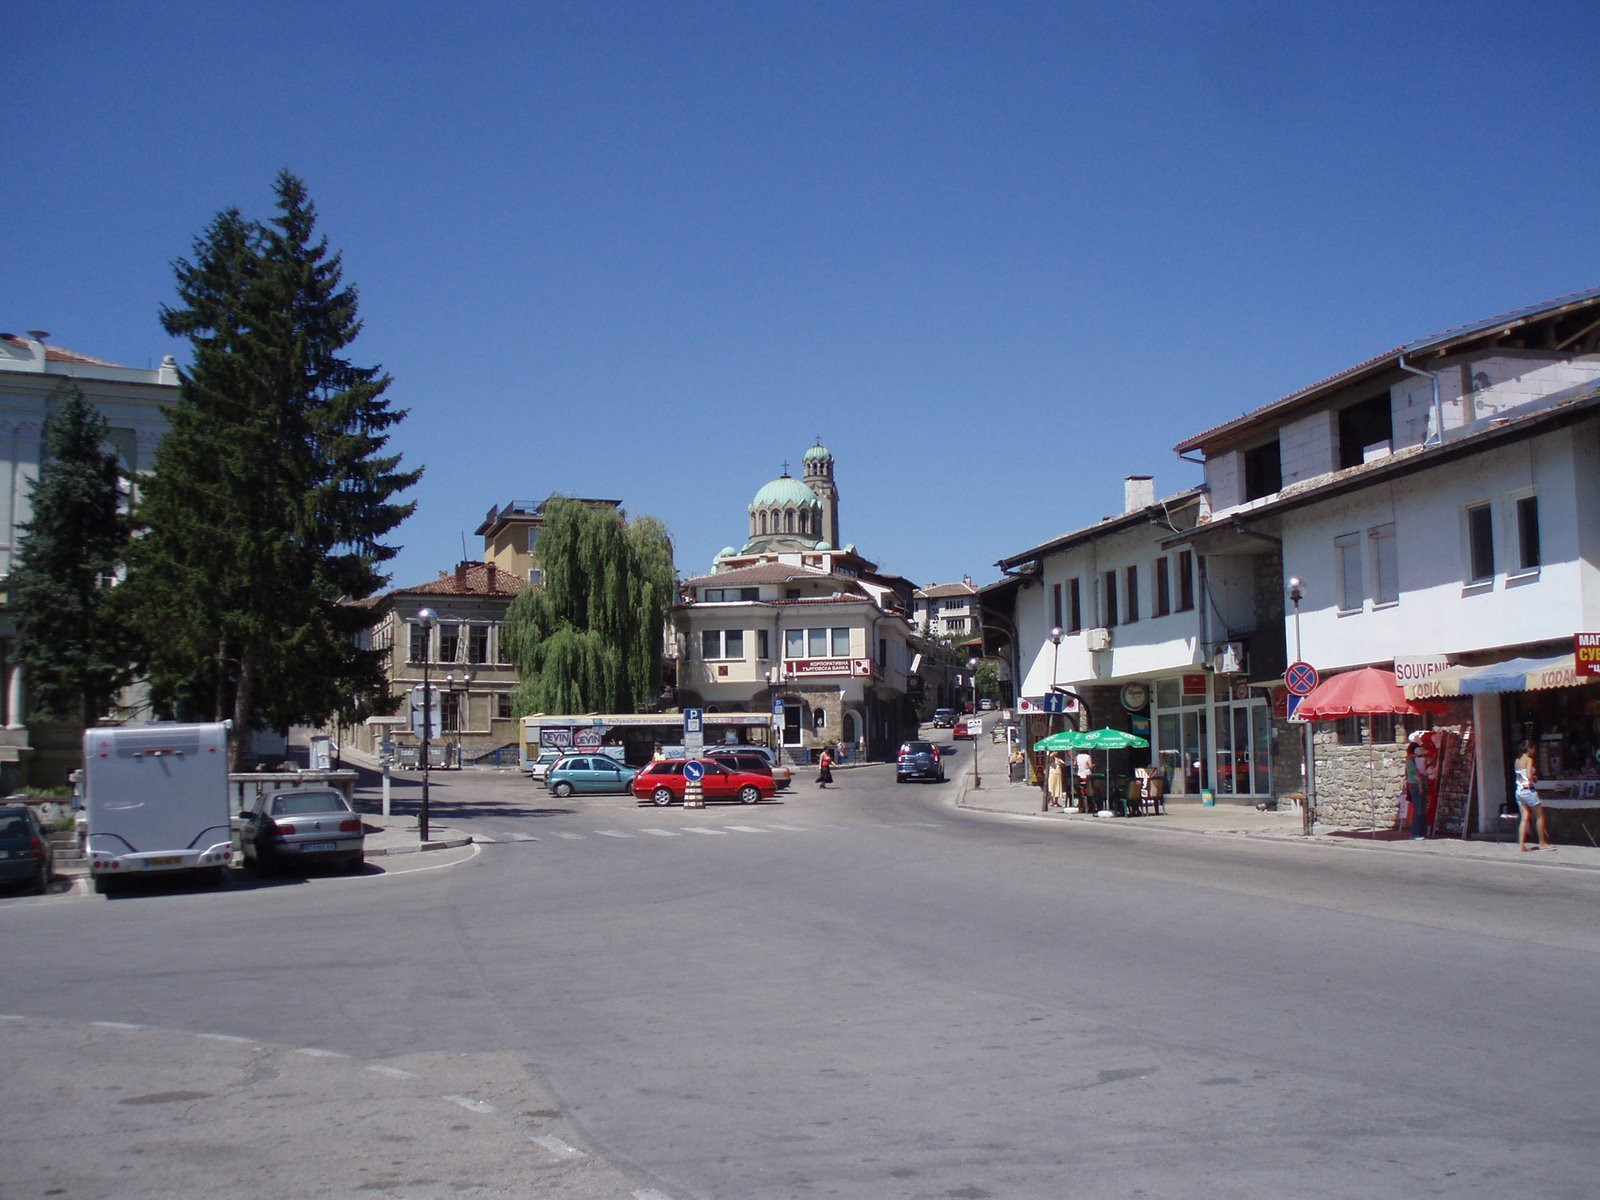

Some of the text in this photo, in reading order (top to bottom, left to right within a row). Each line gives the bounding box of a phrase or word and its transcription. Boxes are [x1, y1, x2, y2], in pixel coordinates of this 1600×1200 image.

[1541, 669, 1577, 687] KODAK
[690, 710, 698, 719] P
[543, 733, 570, 742] DEVIN
[576, 735, 601, 744] DEVIN
